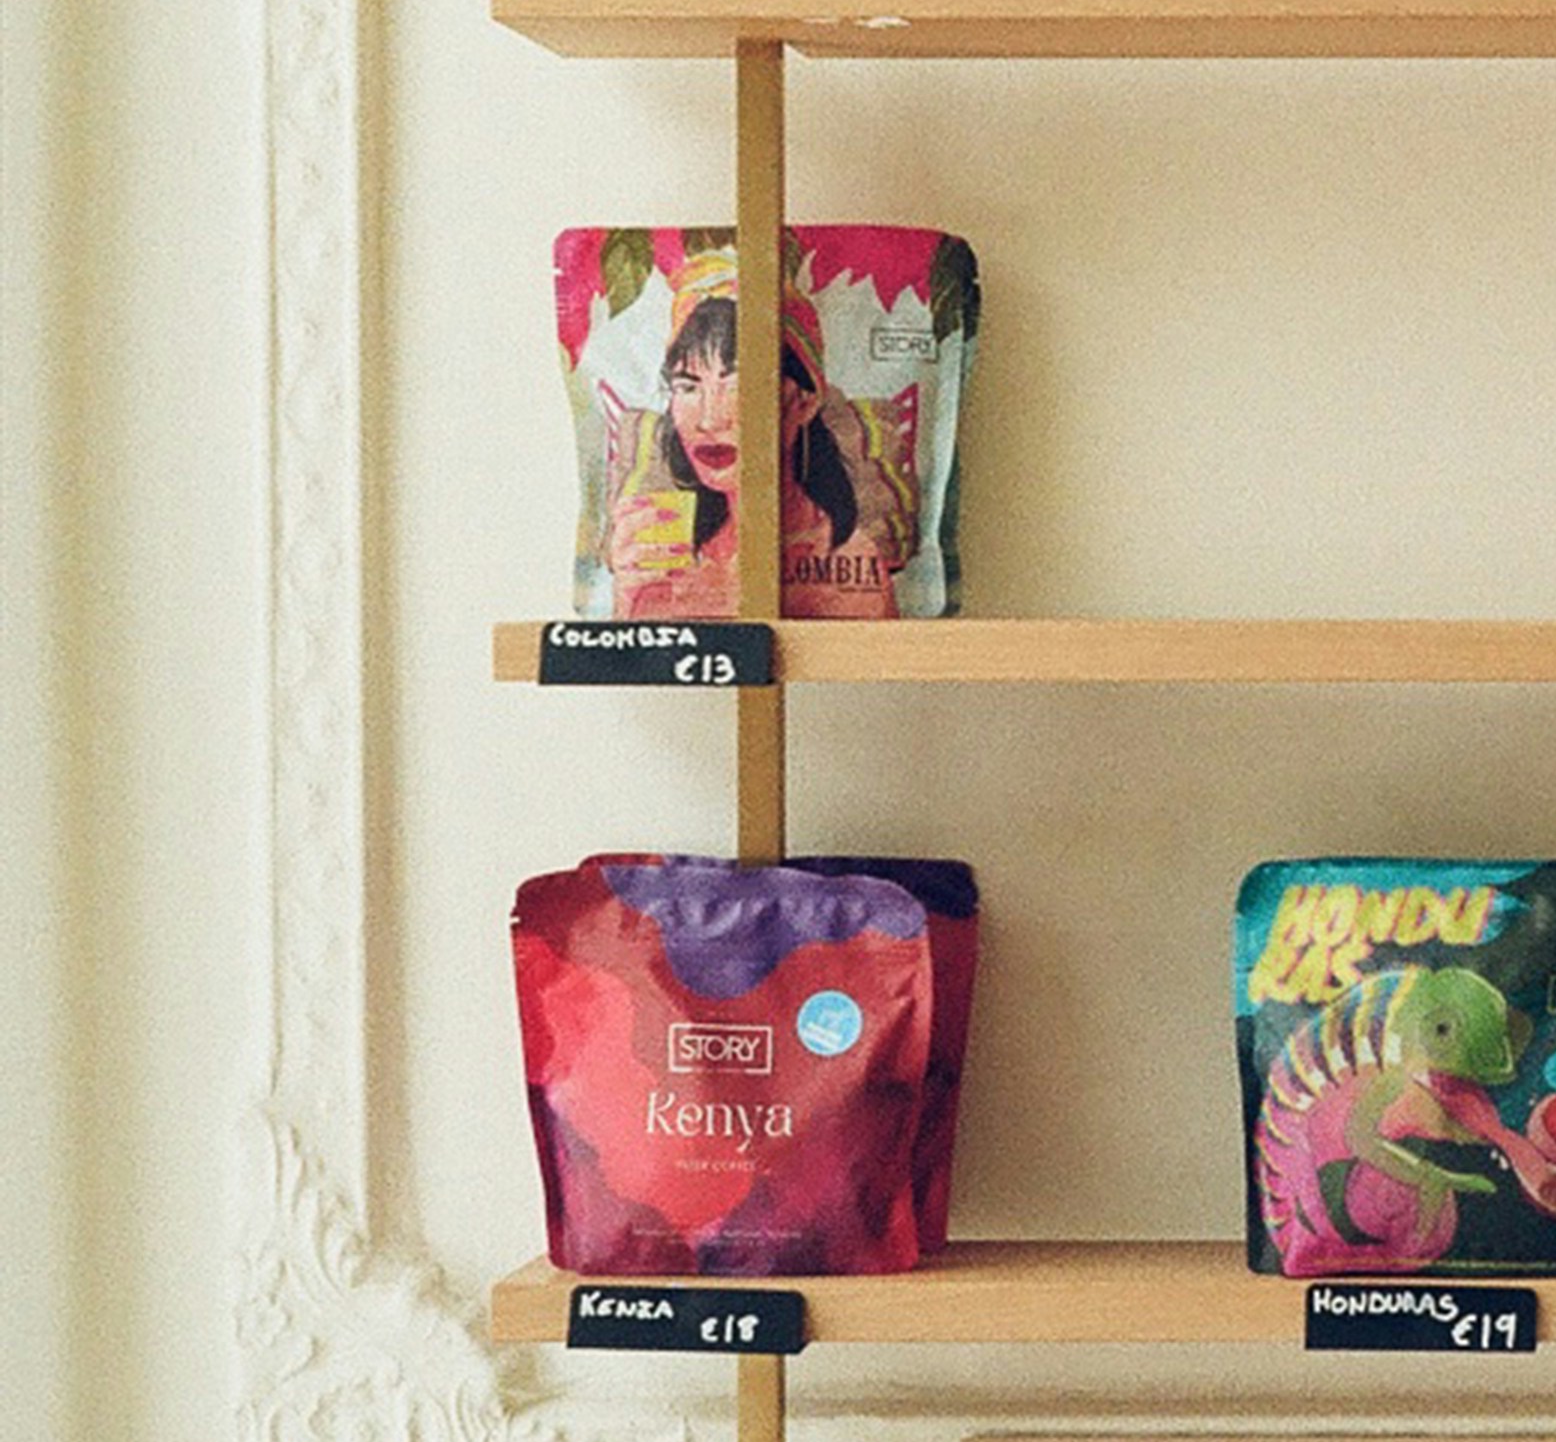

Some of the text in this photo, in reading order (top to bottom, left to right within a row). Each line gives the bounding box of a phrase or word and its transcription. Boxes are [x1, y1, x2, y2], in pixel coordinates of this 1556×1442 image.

[550, 623, 698, 650] COLOMBIA
[1268, 883, 1500, 949] HONDU
[679, 1034, 761, 1062] STORY
[645, 1091, 794, 1154] Kenya
[1312, 1288, 1459, 1322] HONDURAS
[1451, 1314, 1519, 1350] €19
